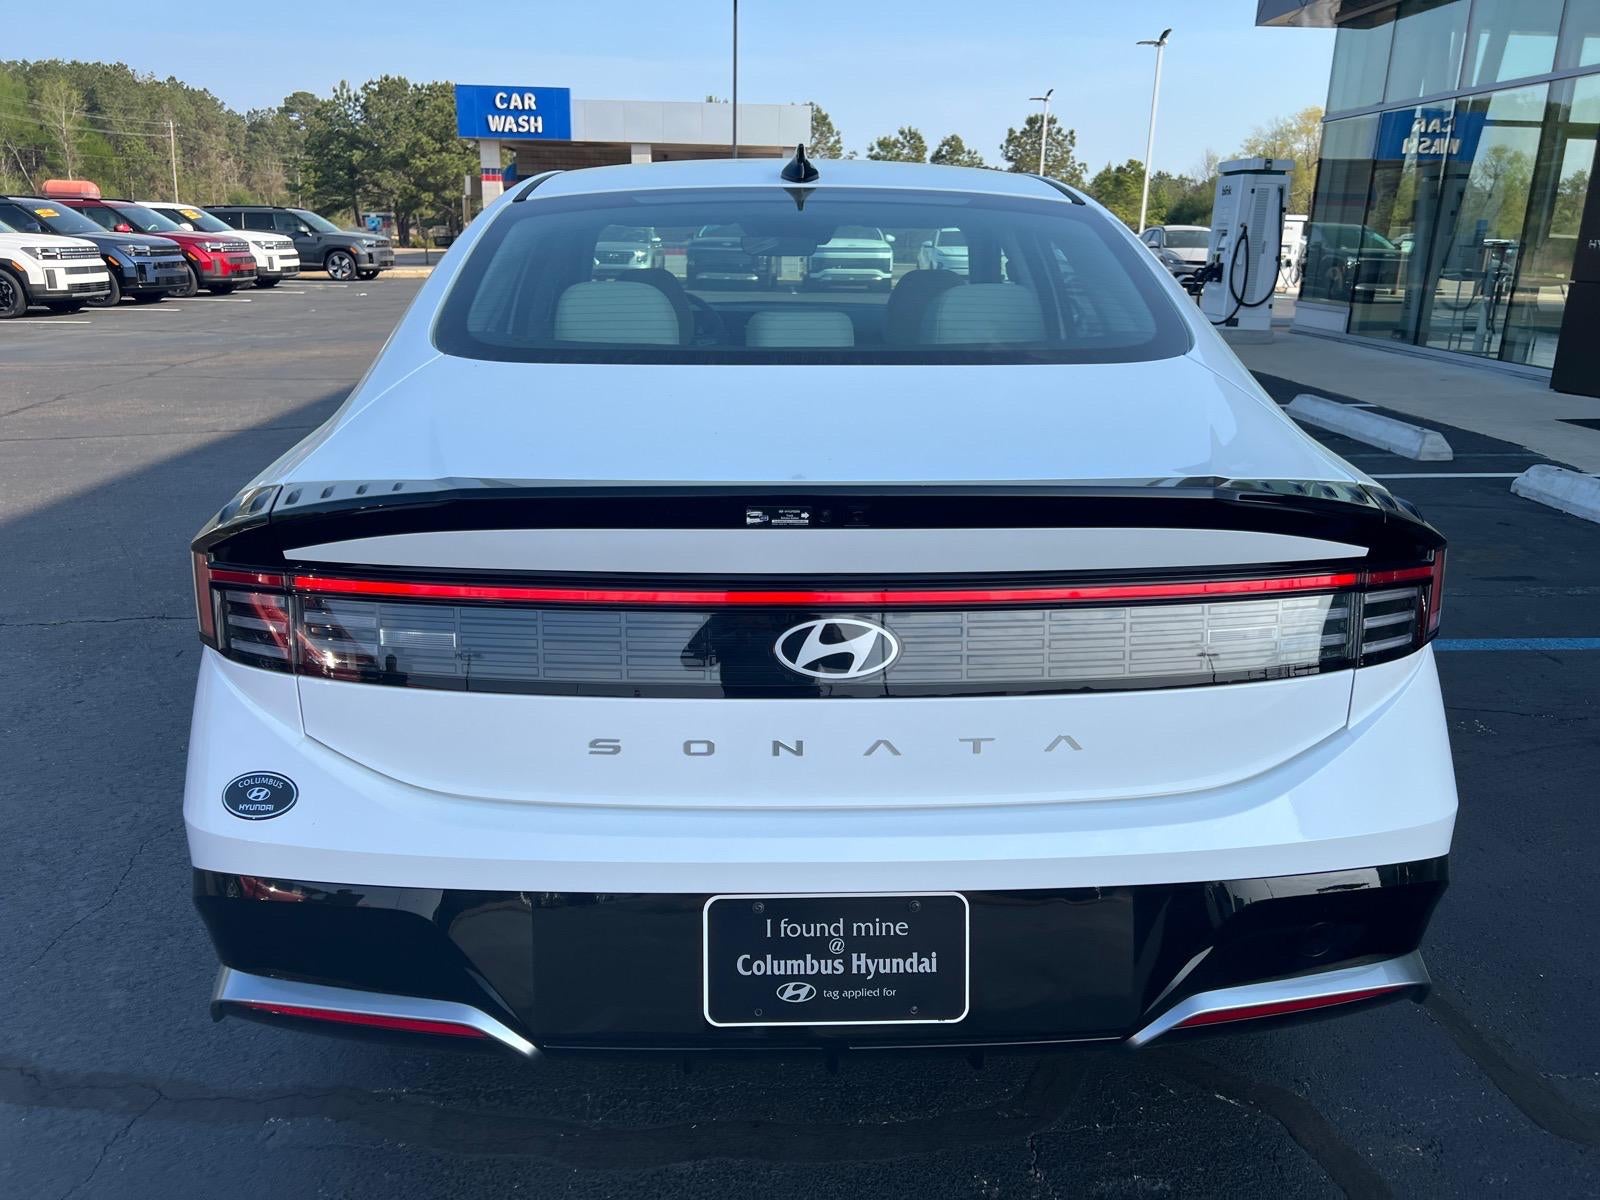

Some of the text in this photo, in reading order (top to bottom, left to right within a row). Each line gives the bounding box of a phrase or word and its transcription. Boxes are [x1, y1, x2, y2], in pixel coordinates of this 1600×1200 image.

[494, 92, 537, 110] CAR
[487, 114, 543, 133] WASH
[588, 735, 1082, 756] SONATA
[238, 777, 284, 789] COLUMBUS
[238, 803, 274, 811] HYUNDAI
[766, 917, 909, 938] I found mine
[828, 937, 845, 955] @
[736, 951, 937, 980] Columbus Hyundai
[823, 987, 897, 1000] tag applied for
